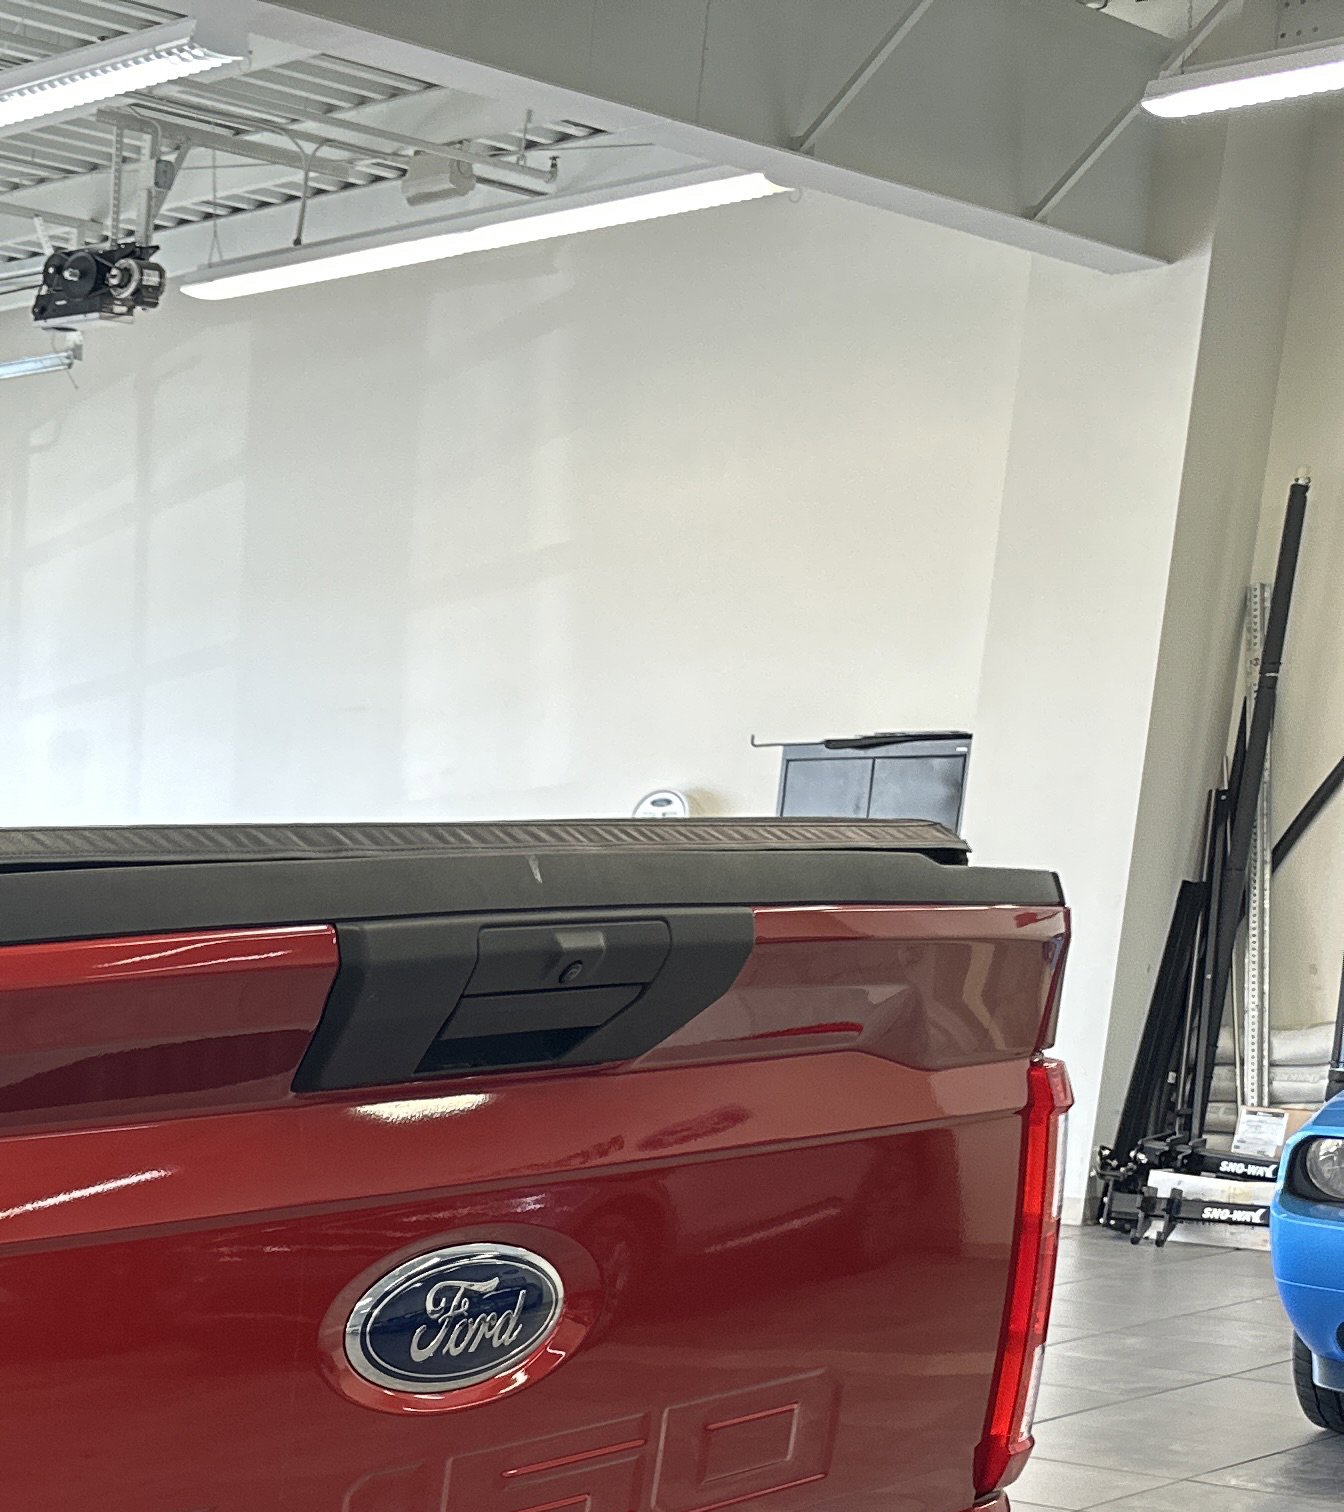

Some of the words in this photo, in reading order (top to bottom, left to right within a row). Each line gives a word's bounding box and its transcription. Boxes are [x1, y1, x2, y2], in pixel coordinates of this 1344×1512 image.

[1219, 1161, 1278, 1178] SNO-WAY
[1201, 1207, 1267, 1224] SNO-WAY
[410, 1276, 527, 1363] Ford
